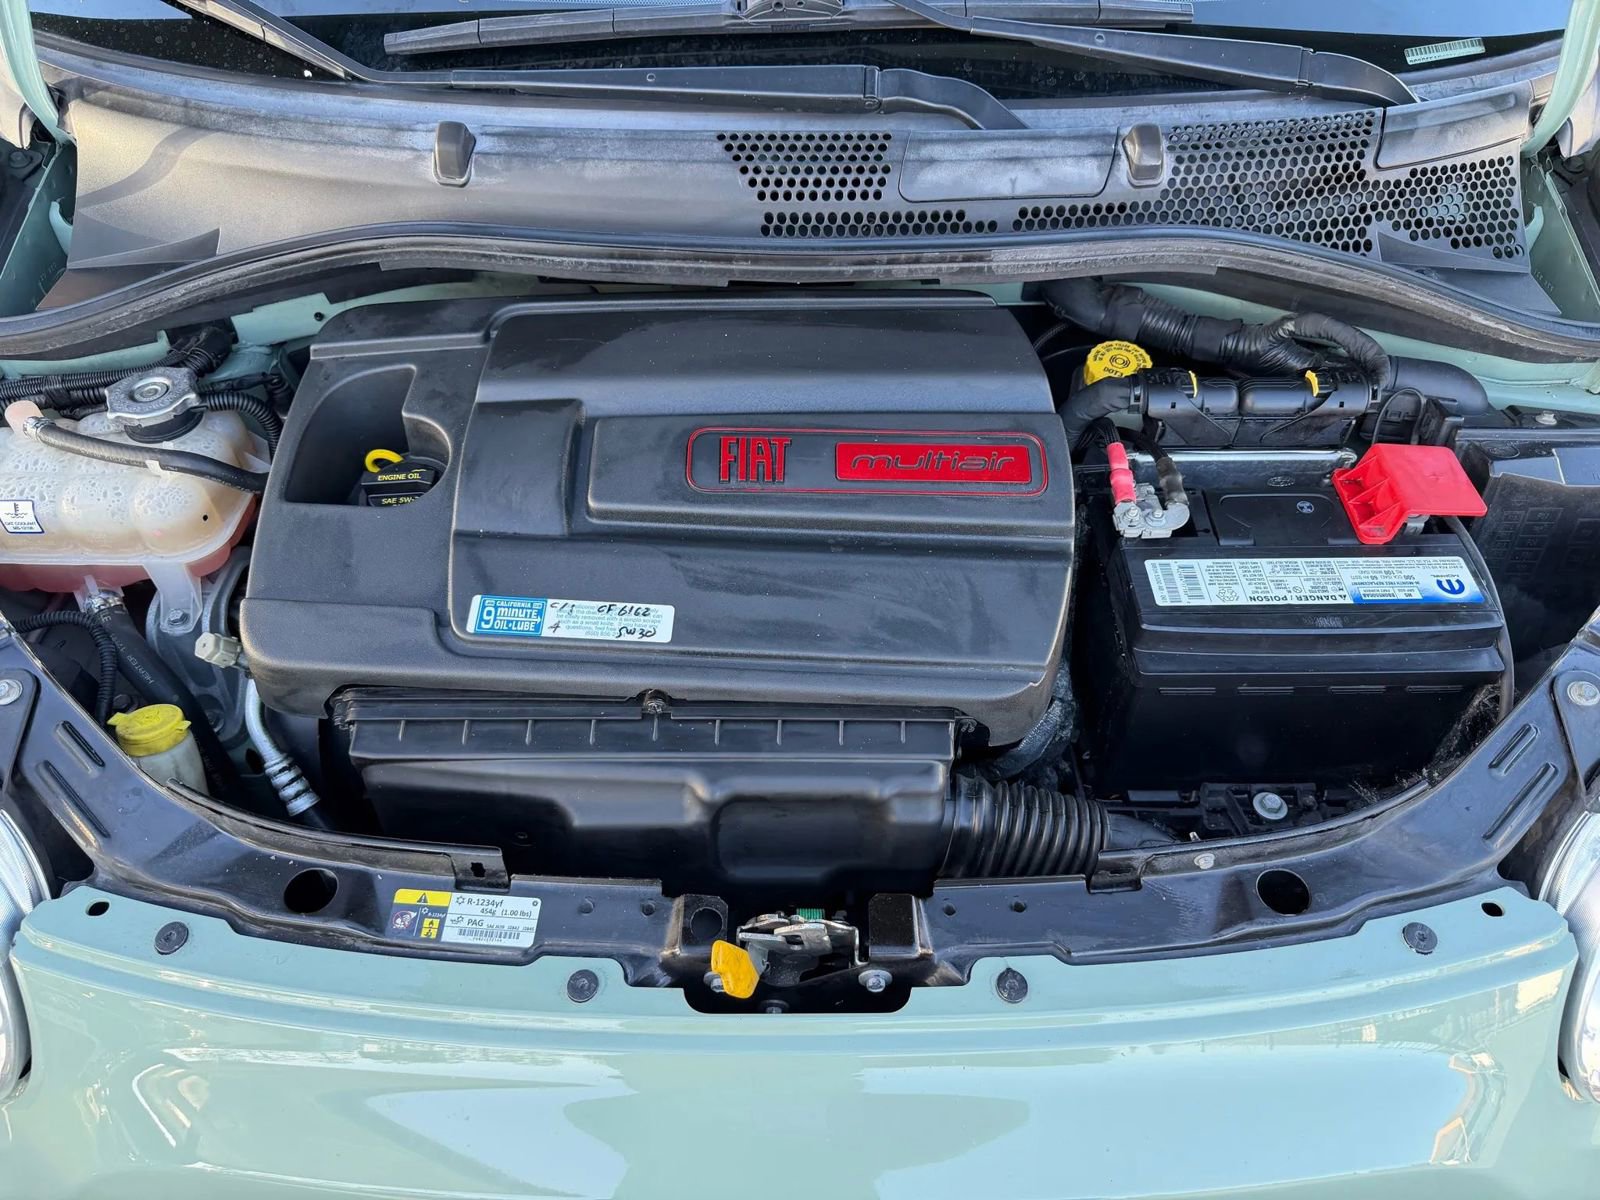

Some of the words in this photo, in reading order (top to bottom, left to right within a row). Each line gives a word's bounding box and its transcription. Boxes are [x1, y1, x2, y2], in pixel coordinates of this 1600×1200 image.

[719, 436, 792, 483] FIAT
[851, 450, 1016, 471] multiair
[378, 473, 406, 481] ENGINE
[496, 600, 532, 608] CALIFORNIA
[480, 606, 496, 629] 9
[127, 655, 155, 684] HEATER
[466, 898, 504, 908] R-1234yf
[480, 908, 497, 916] 454g
[501, 908, 518, 916] (1.00
[519, 910, 532, 918] lbs)
[466, 918, 484, 928] PAG
